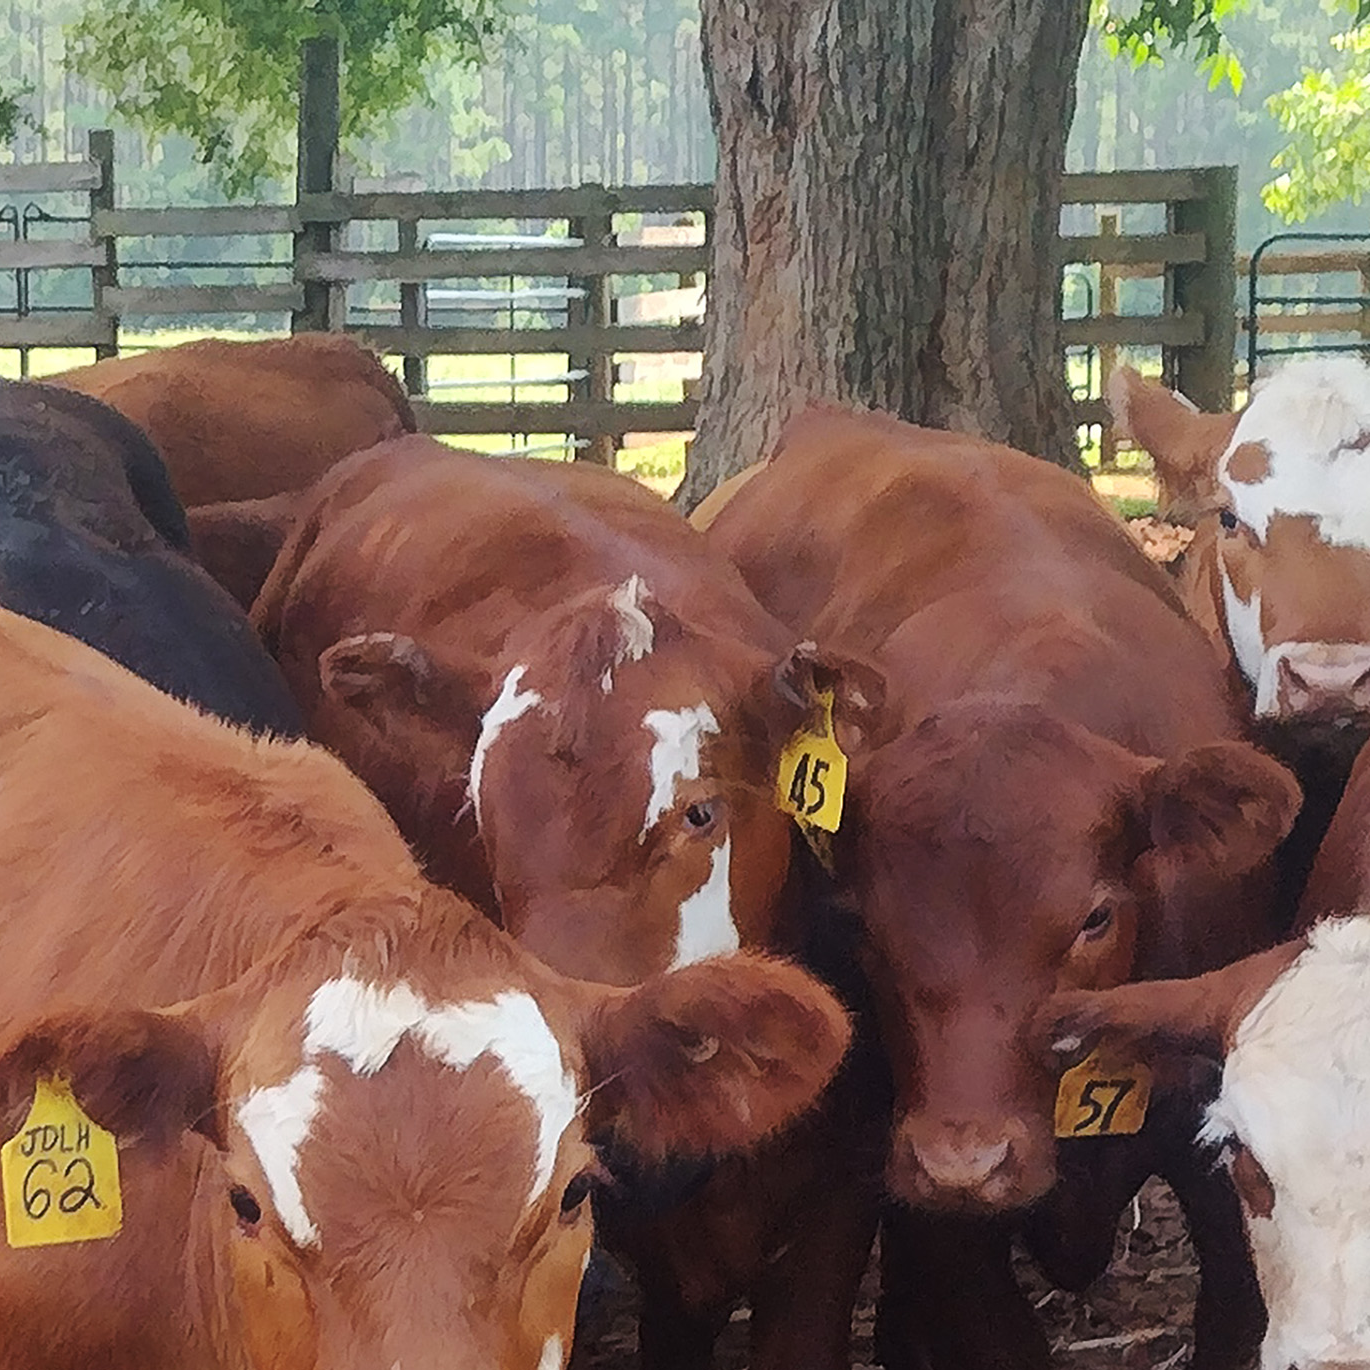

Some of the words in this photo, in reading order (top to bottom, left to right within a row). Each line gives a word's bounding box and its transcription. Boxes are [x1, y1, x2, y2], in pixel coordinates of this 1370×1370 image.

[788, 752, 830, 816] 45
[1073, 1078, 1137, 1134] 57
[21, 1123, 90, 1158] JDLH
[23, 1157, 102, 1220] 62
